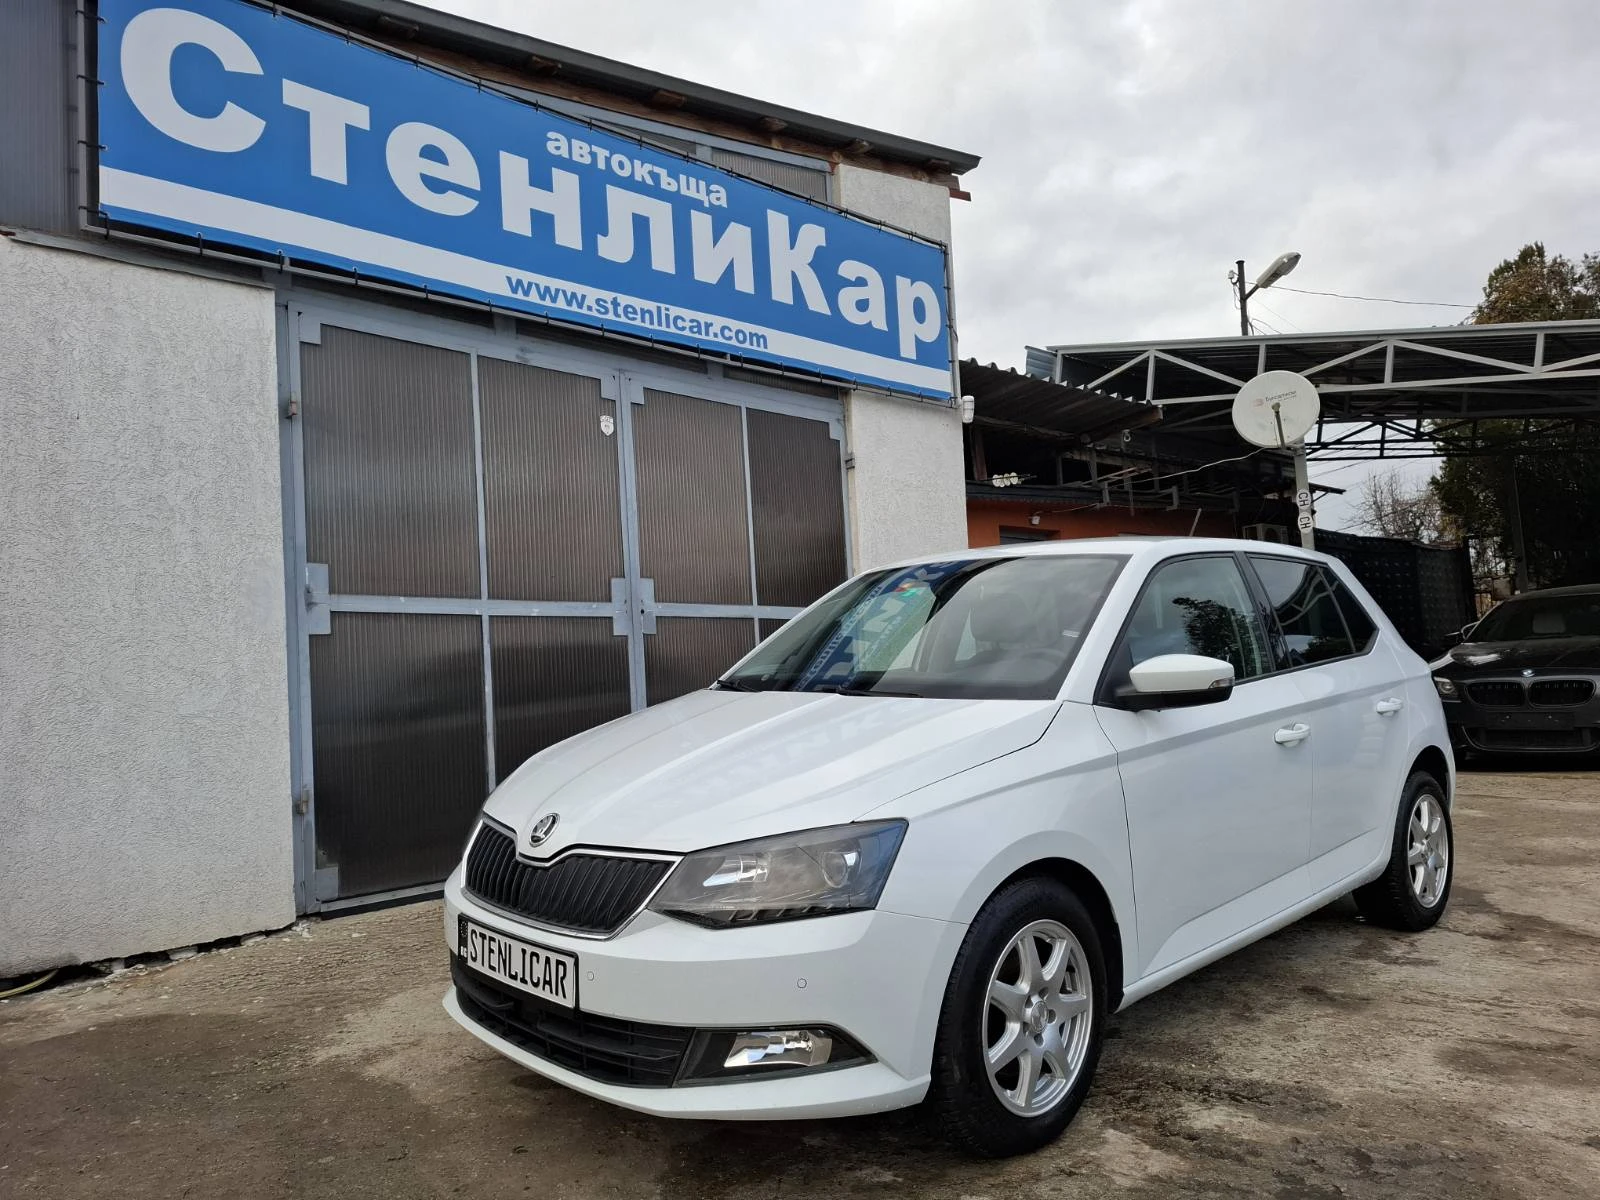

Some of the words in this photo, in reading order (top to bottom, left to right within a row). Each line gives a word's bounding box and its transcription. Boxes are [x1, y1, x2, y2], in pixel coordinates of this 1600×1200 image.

[120, 8, 942, 360] СтенлиКар
[545, 131, 728, 209] автокъща
[505, 275, 769, 351] www.stenlicar.com
[1298, 492, 1309, 508] CH
[1299, 516, 1310, 531] CH
[470, 928, 567, 999] STENLICAR
